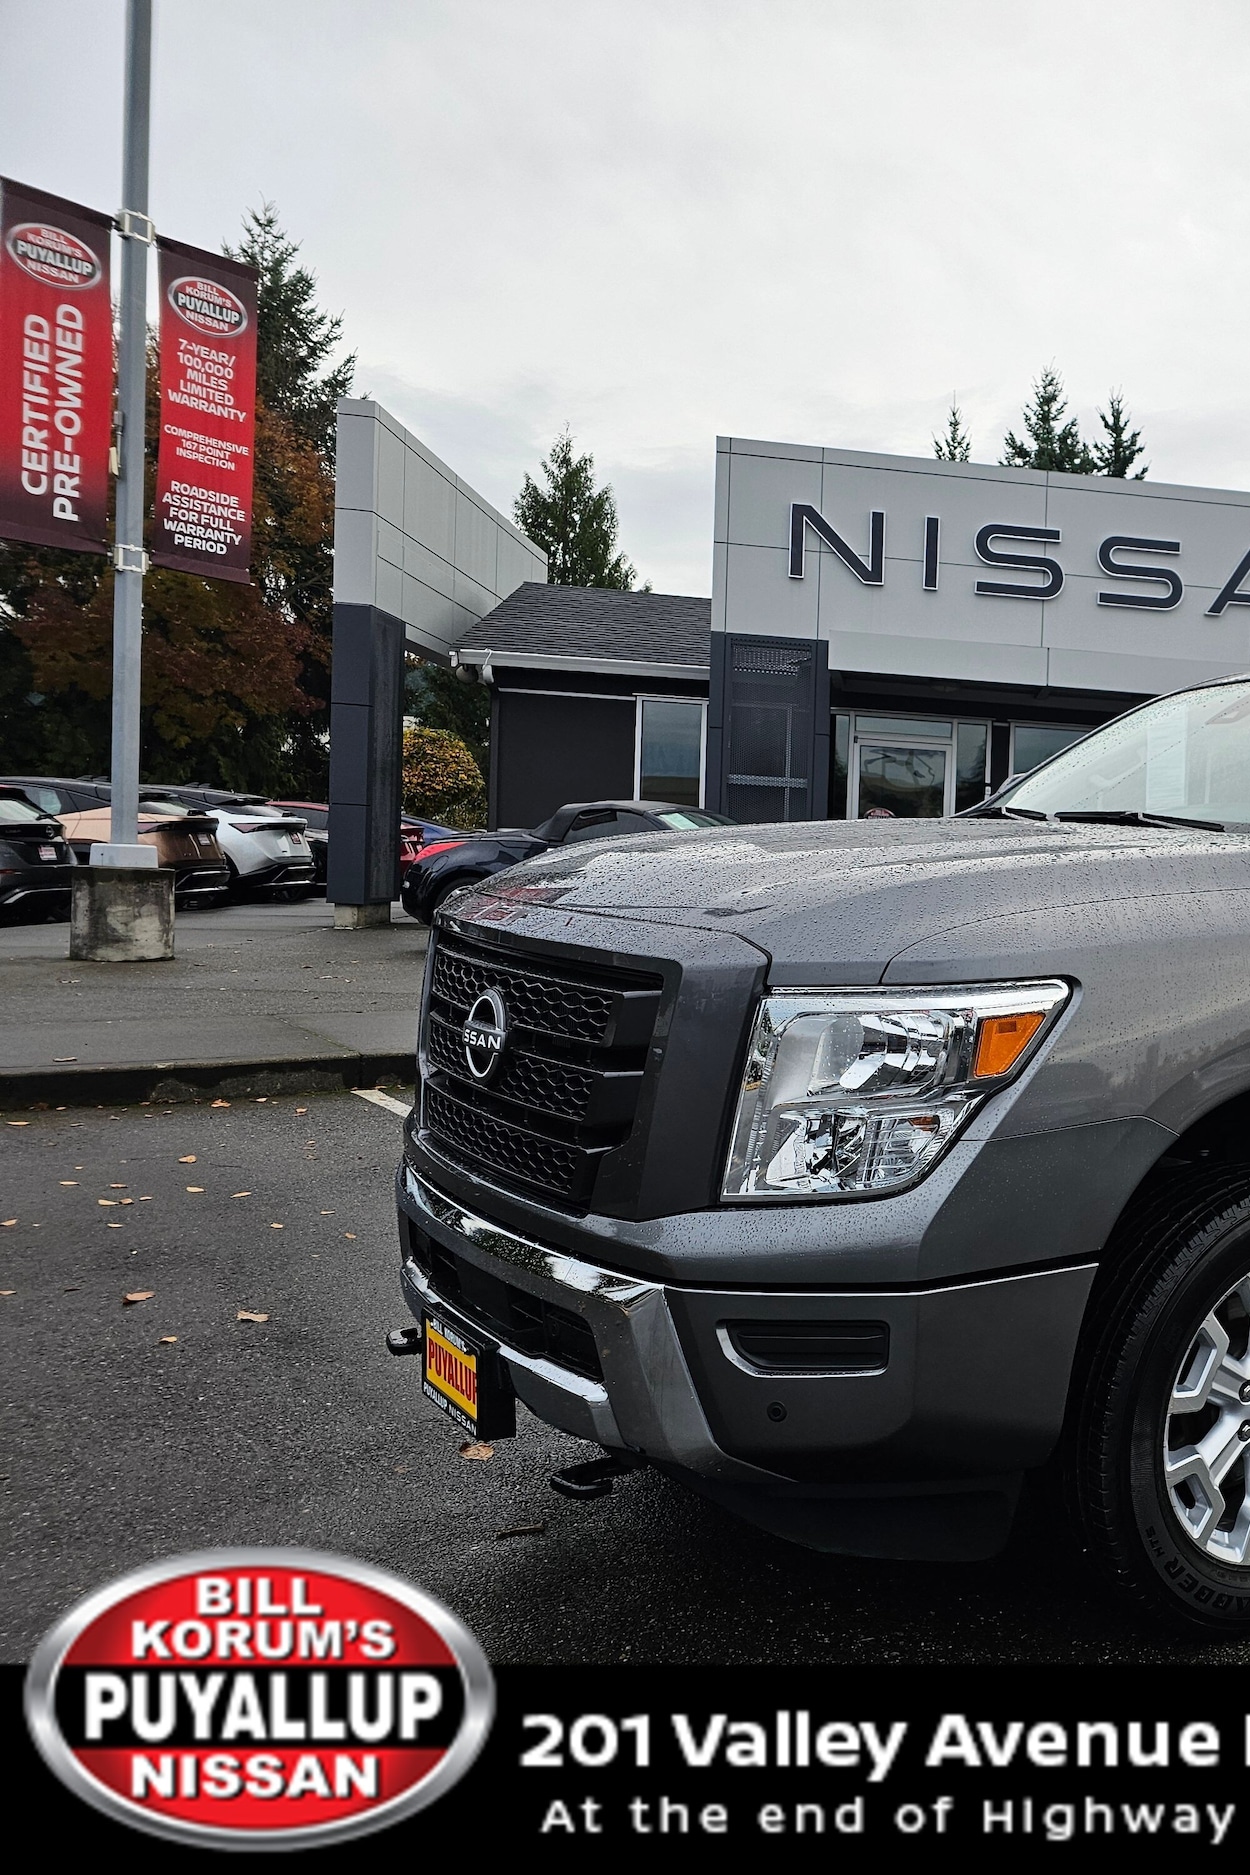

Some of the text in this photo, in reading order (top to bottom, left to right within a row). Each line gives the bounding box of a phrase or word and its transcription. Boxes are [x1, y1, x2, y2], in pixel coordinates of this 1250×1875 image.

[41, 228, 68, 245] BILL
[17, 239, 93, 275] PUYALLUP
[27, 259, 79, 284] NISSAN
[186, 286, 232, 308] KORUM'S
[197, 281, 219, 296] BILL
[178, 293, 239, 324] PUYALLUP
[186, 310, 229, 332] NISSAN
[177, 351, 235, 380] 100,000
[178, 338, 236, 367] 7-YEAR/
[180, 379, 235, 406] LIMITED
[186, 368, 229, 391] MILES
[21, 313, 51, 496] CERTIFIED
[52, 303, 84, 522] PRE-OWNED
[167, 388, 247, 423] WARRANTY
[163, 424, 249, 456] COMPREHENSIVE
[181, 438, 232, 460] 167 POINT
[176, 446, 236, 471] INSPECTION
[162, 492, 246, 522] ASSISTANCE
[171, 480, 240, 508] ROADSIDE
[163, 518, 243, 546] WARRANTY
[169, 506, 235, 532] FOR FULL
[174, 533, 228, 555] PERIOD
[464, 1028, 501, 1050] SSAN
[449, 1404, 477, 1436] NISSAN
